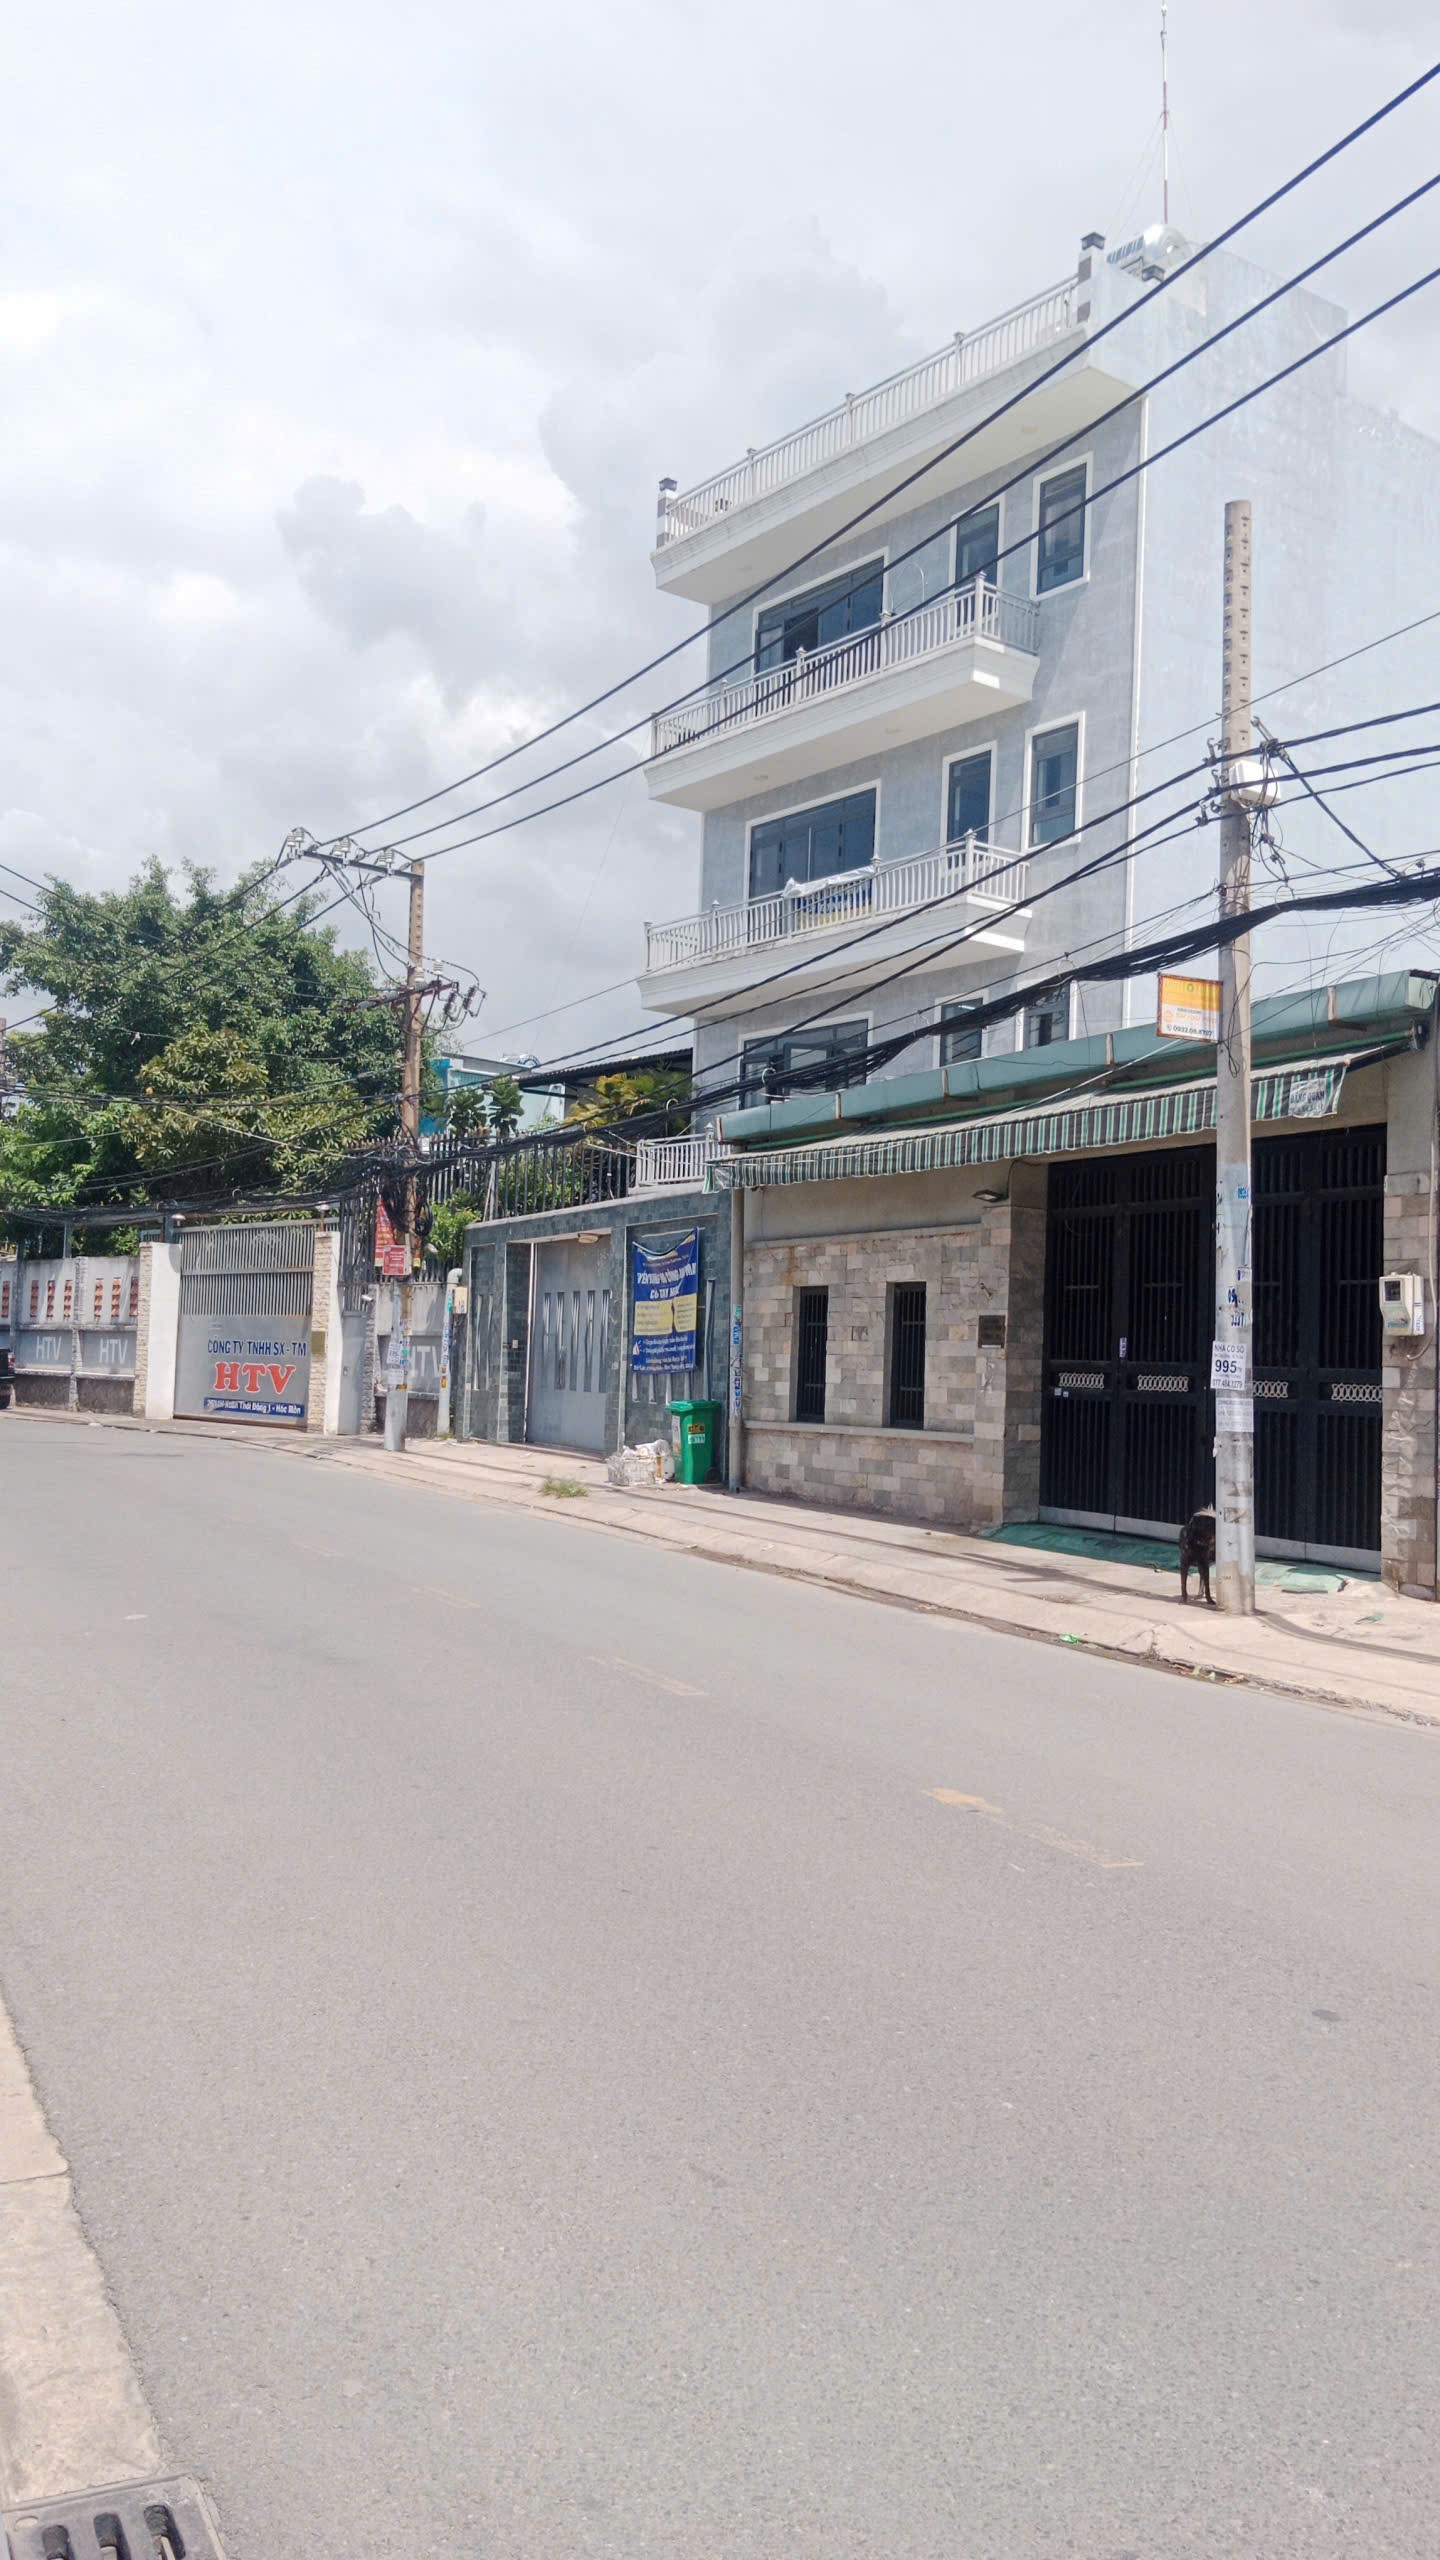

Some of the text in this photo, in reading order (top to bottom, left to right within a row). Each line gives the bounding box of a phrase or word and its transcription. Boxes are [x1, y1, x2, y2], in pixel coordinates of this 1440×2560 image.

[35, 1335, 62, 1361] HTV
[99, 1338, 128, 1364] HTV
[233, 1341, 243, 1354] TY
[247, 1341, 271, 1355] TNHH
[273, 1342, 285, 1356] SX
[291, 1342, 307, 1357] TM
[213, 1361, 297, 1395] HTV
[1215, 1359, 1237, 1373] 995
